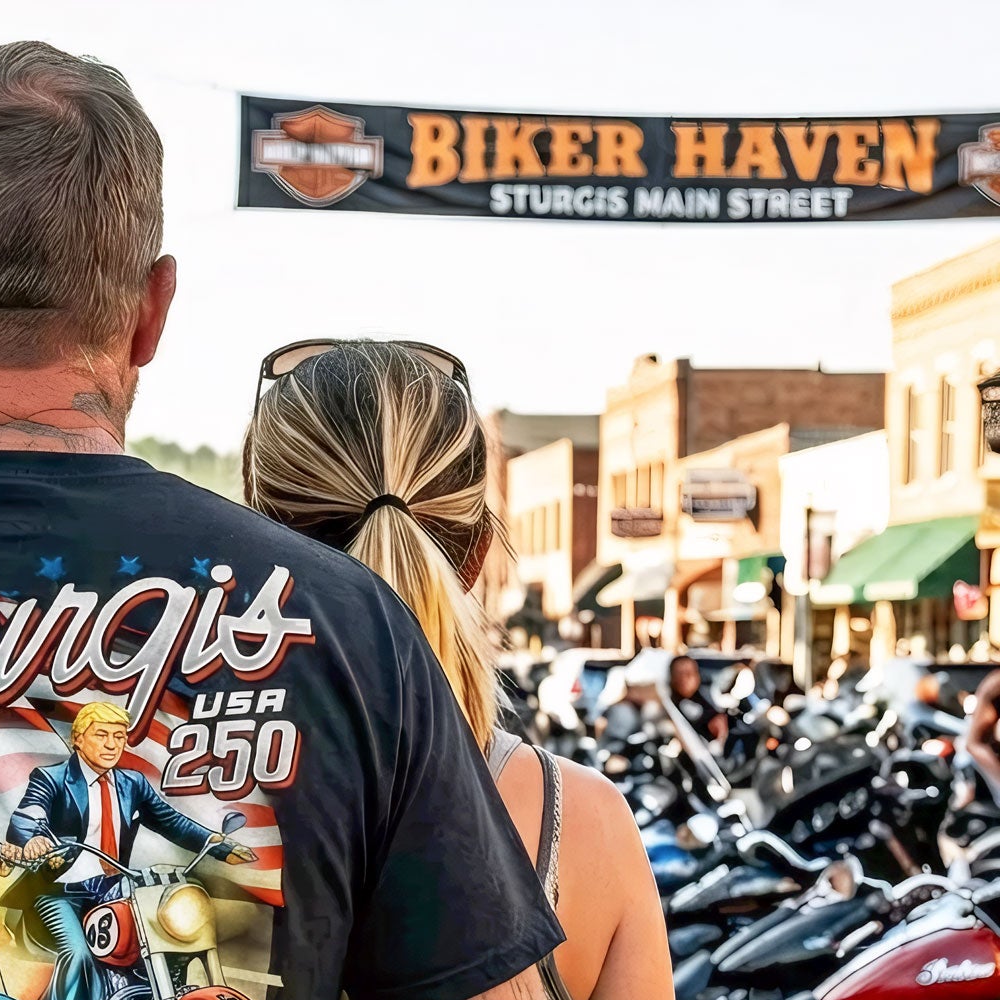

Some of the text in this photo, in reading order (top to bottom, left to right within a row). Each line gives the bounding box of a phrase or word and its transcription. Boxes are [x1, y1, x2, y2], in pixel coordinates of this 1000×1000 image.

[406, 112, 648, 189] BIKER
[670, 118, 941, 194] HAVEN
[633, 186, 720, 219] MAIN
[727, 186, 853, 219] STREET
[192, 688, 288, 719] USA
[163, 719, 300, 796] 250
